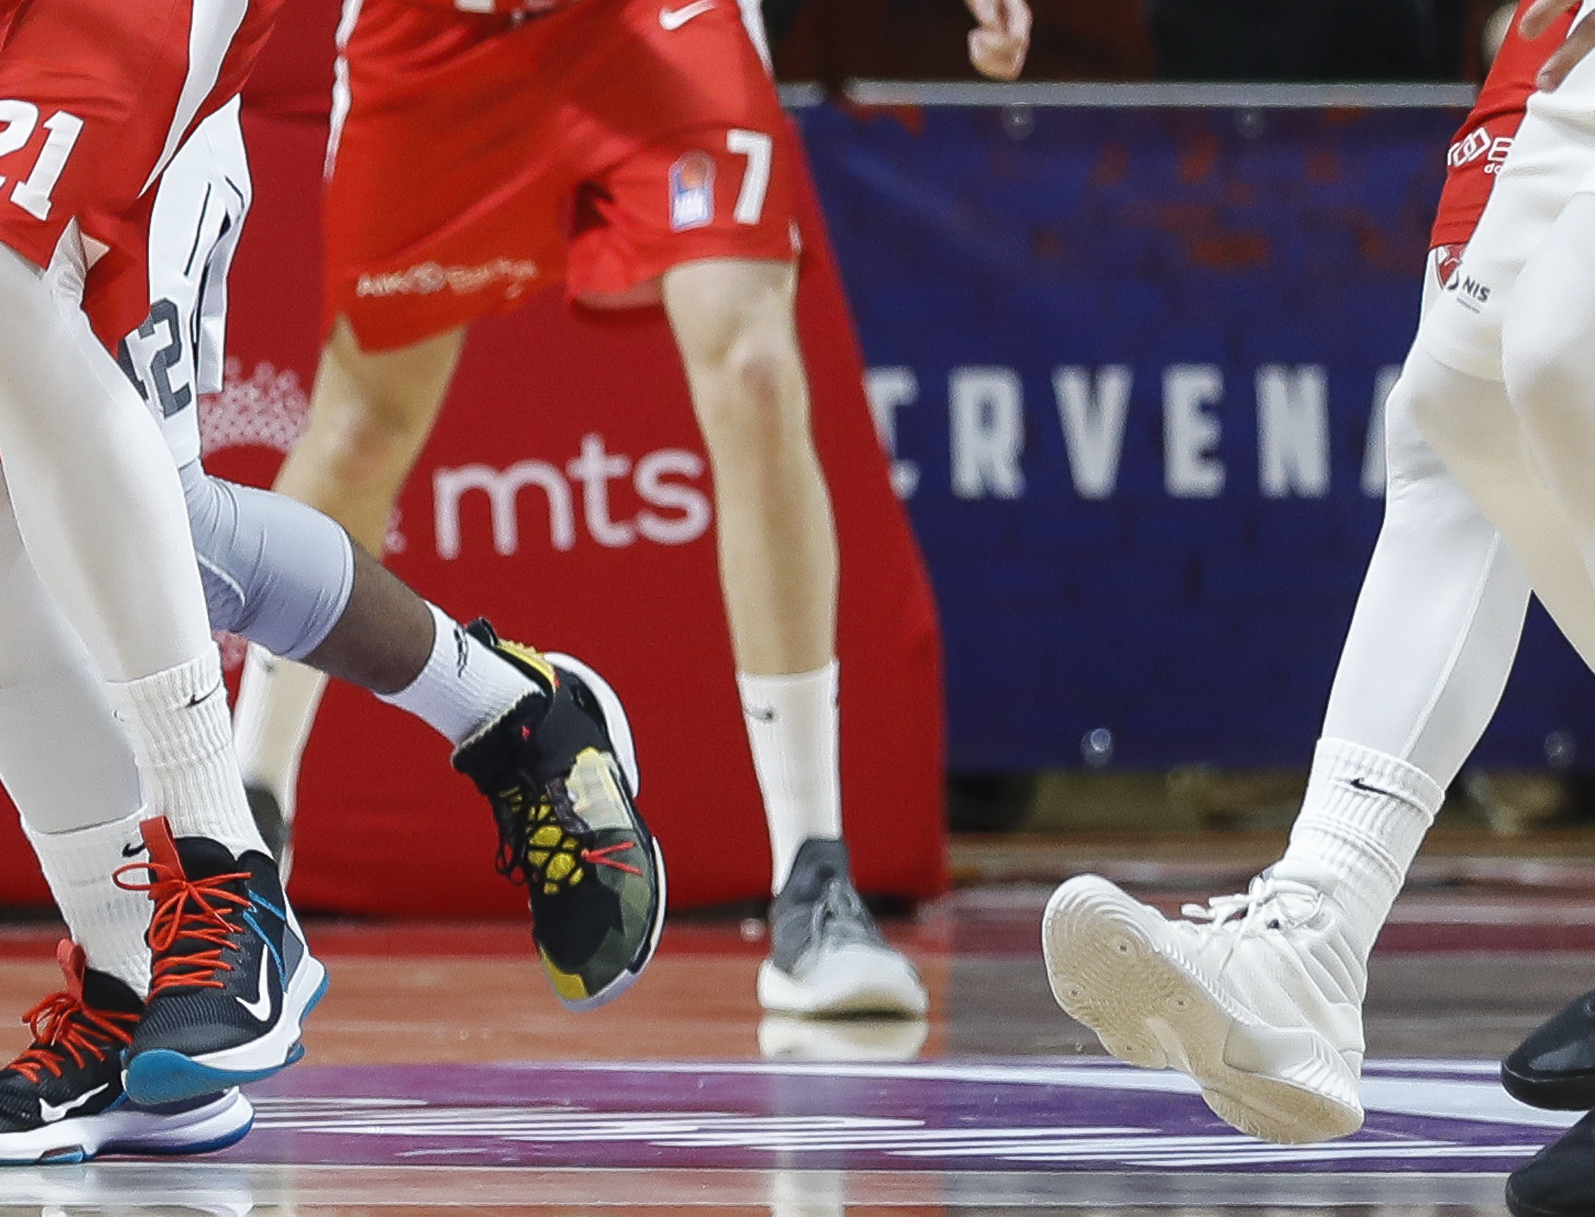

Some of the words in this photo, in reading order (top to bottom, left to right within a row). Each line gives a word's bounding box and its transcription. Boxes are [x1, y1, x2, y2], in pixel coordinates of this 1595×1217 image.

[726, 129, 772, 225] 7
[1462, 275, 1491, 303] NIS
[433, 432, 712, 560] mts
